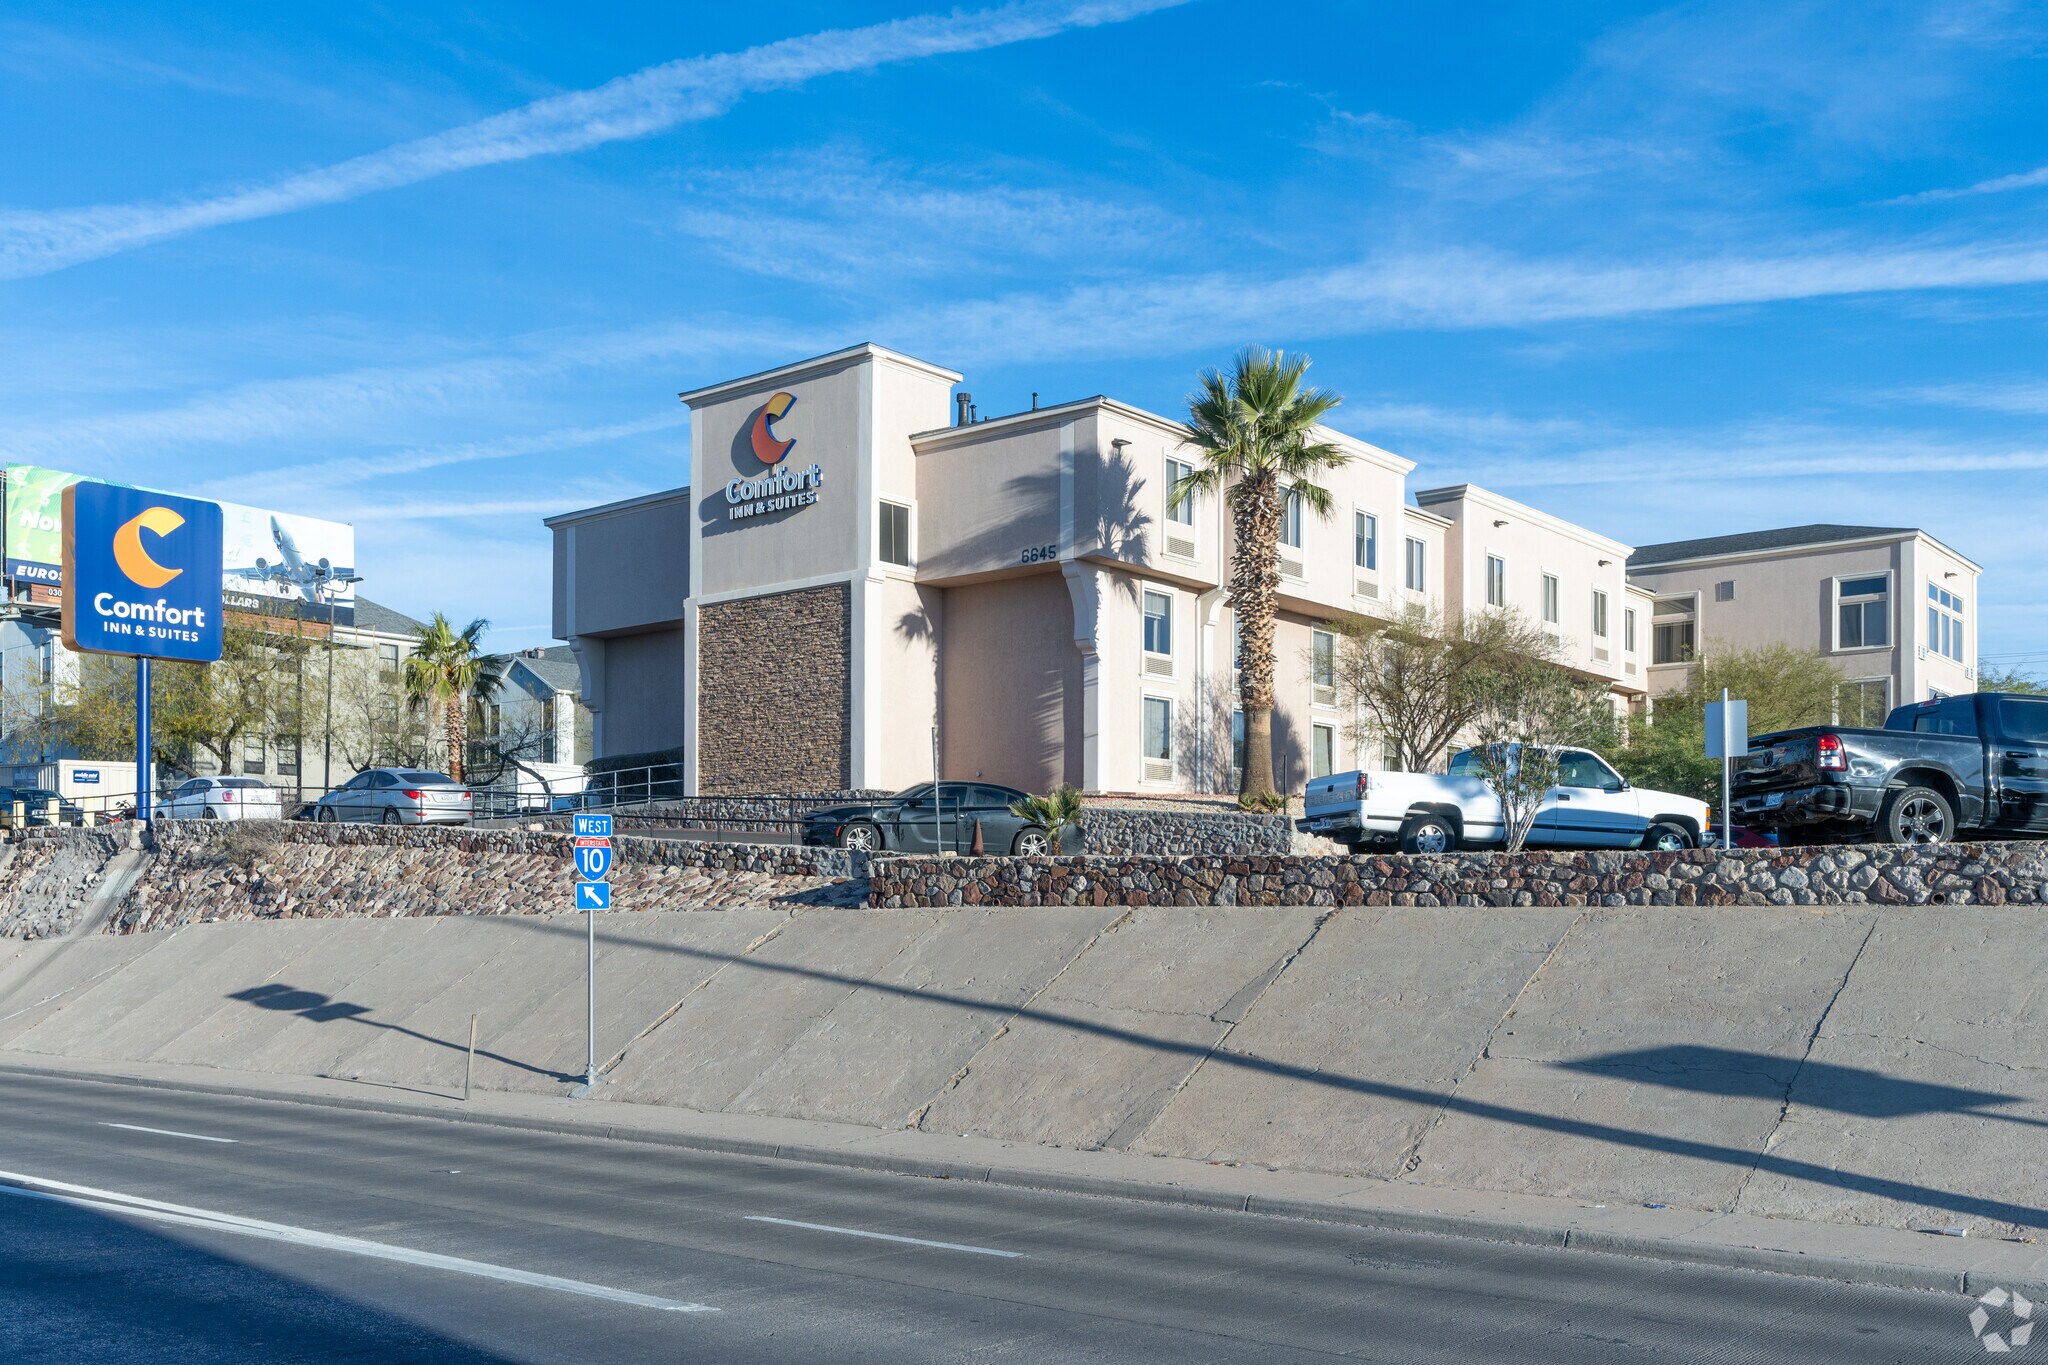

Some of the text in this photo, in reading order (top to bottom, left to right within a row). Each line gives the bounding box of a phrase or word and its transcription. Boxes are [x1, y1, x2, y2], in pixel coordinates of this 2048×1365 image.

[725, 463, 822, 504] Comfort
[729, 491, 816, 520] INN & SUITES
[1021, 544, 1057, 563] 6645
[94, 592, 205, 627] Comfort
[104, 621, 199, 642] INN & SUITES
[578, 818, 608, 834] WEST
[582, 848, 604, 873] 10
